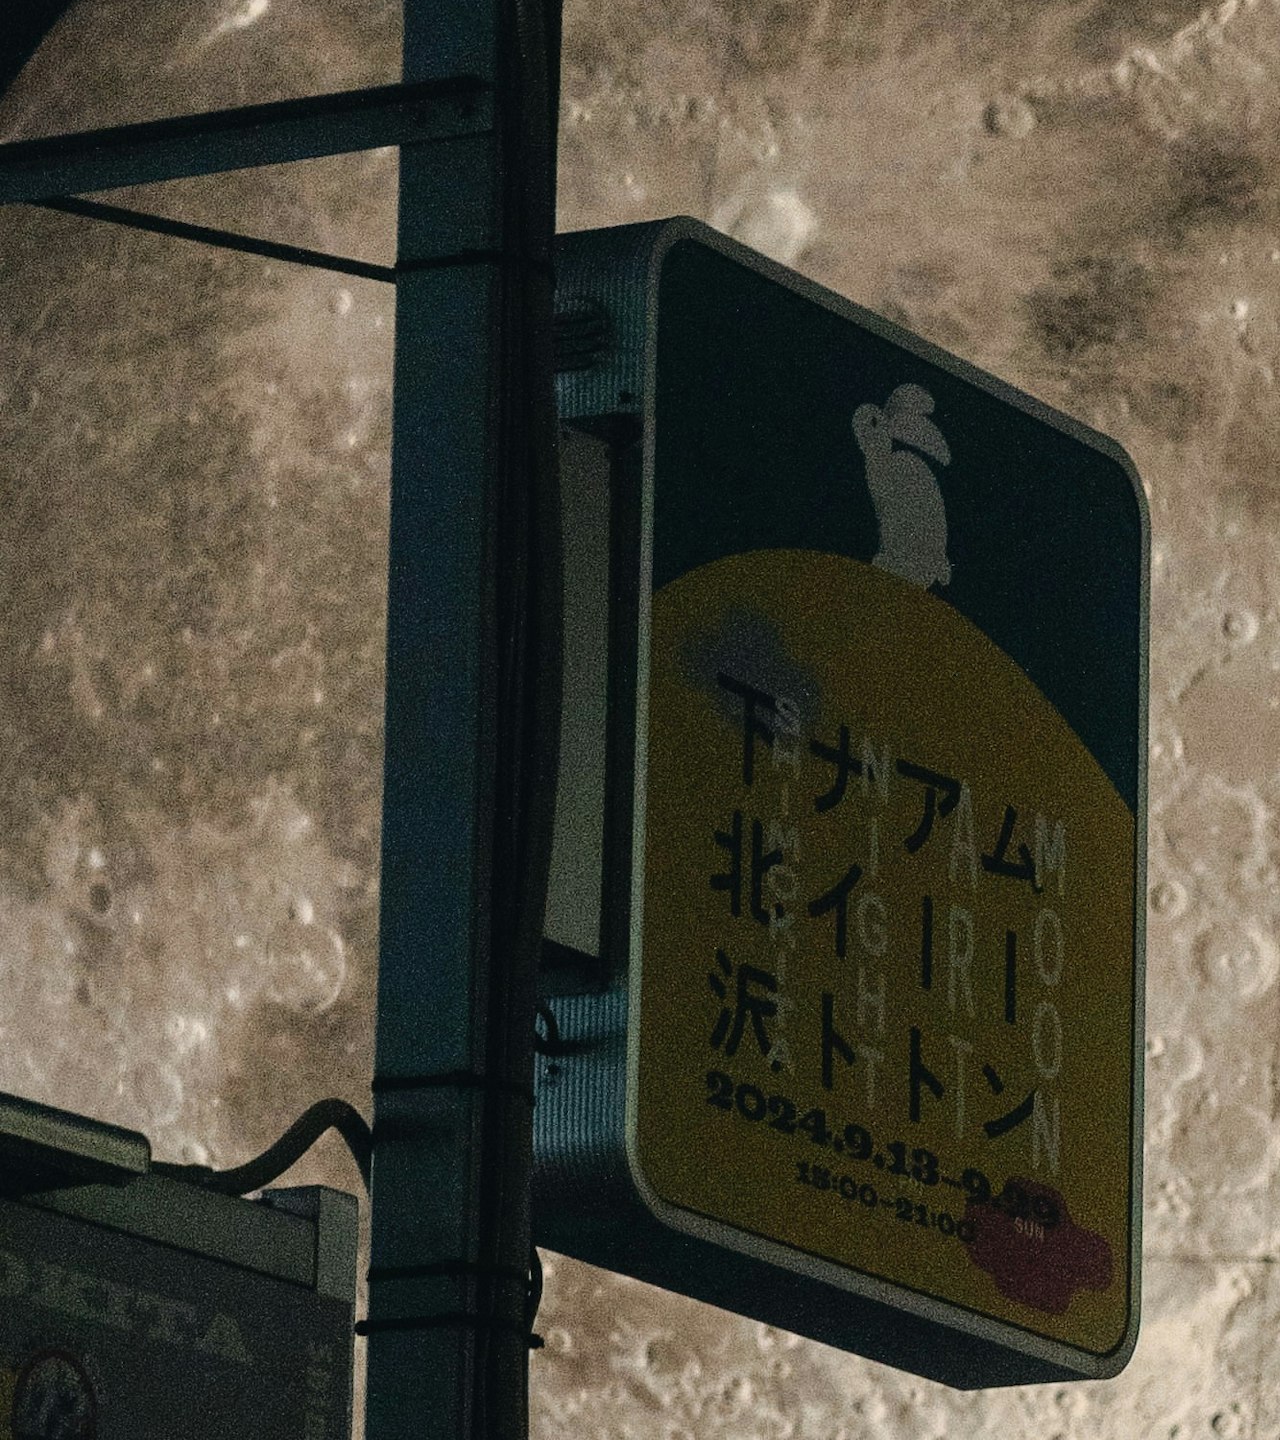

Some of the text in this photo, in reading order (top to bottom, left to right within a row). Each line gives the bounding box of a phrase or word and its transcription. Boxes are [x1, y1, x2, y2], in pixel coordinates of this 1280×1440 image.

[709, 673, 782, 1070] 下北沢
[809, 725, 874, 1090] ナイト
[855, 737, 890, 1109] NIGHT
[897, 759, 961, 1121] アート
[948, 779, 977, 1140] ART
[981, 806, 1043, 1137] ムーン
[1031, 811, 1066, 1176] MOON
[1013, 1215, 1045, 1243] SUN
